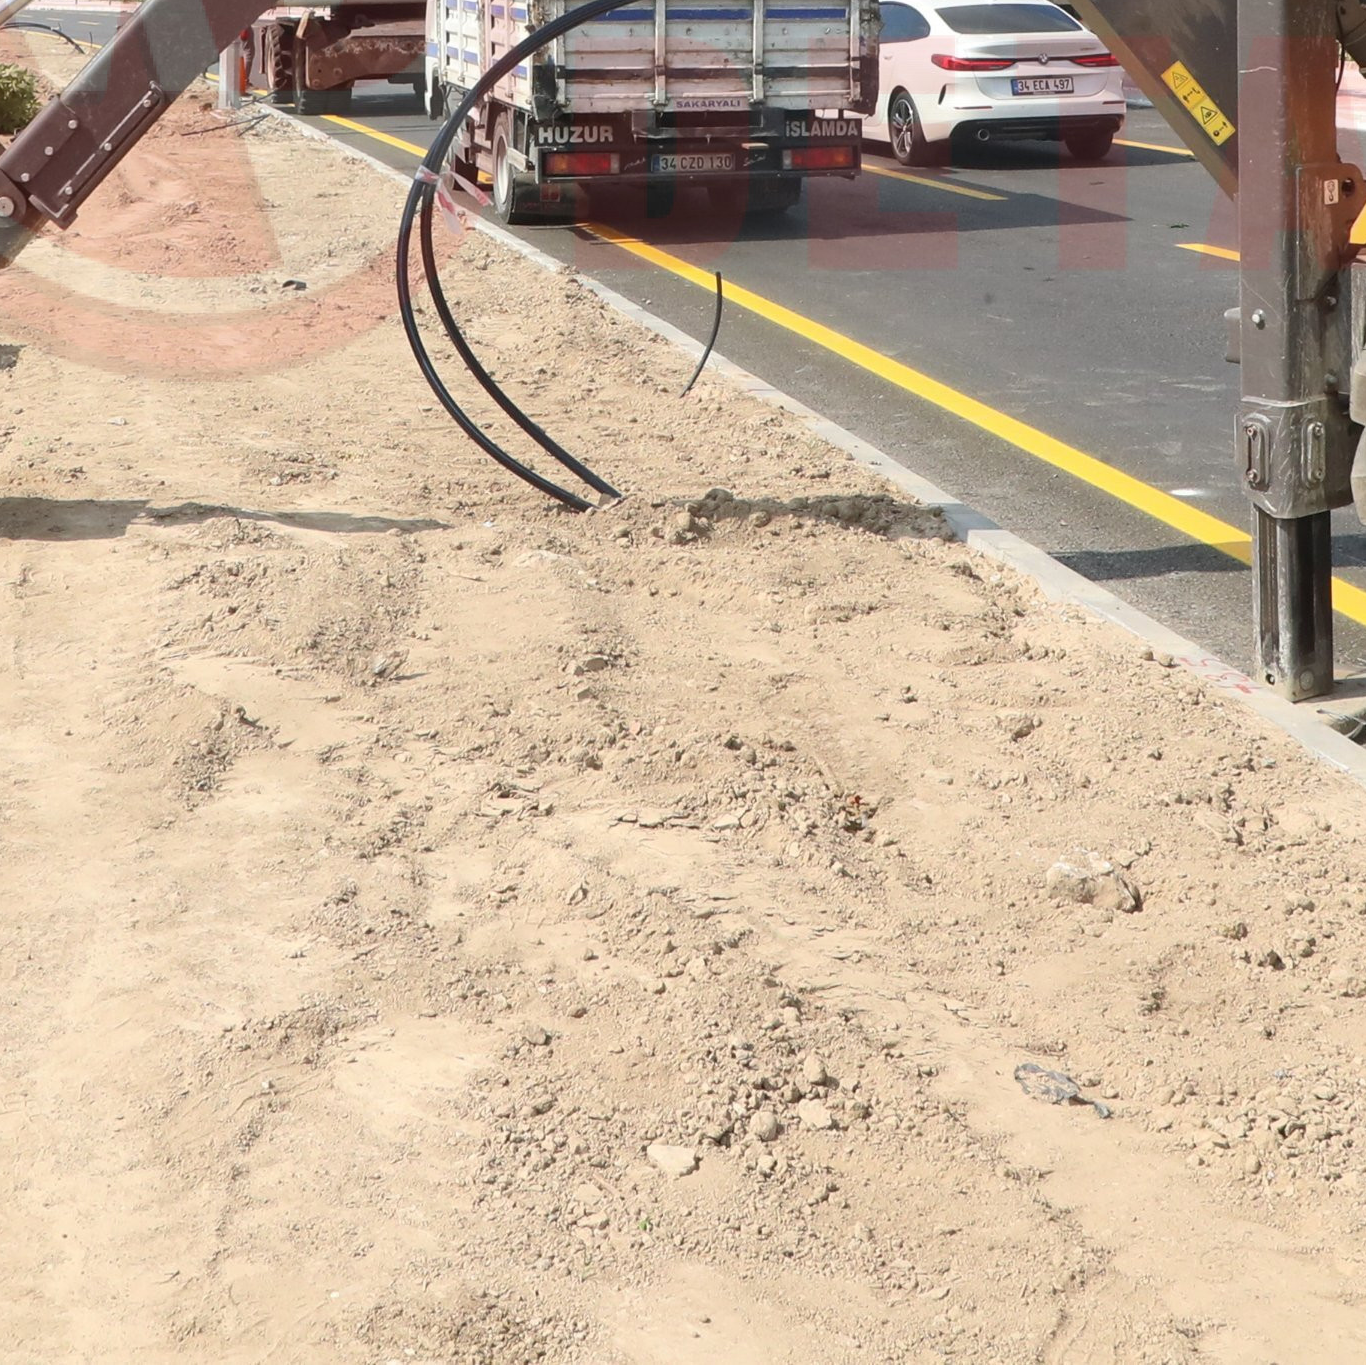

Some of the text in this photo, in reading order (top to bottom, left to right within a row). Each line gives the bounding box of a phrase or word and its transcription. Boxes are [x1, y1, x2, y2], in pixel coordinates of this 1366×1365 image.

[1018, 79, 1070, 91] 34 ECA 497
[676, 100, 741, 109] SAKARYALI
[538, 125, 614, 144] HUZUR
[661, 158, 677, 171] 34
[680, 157, 705, 170] CZD
[709, 155, 732, 169] 130
